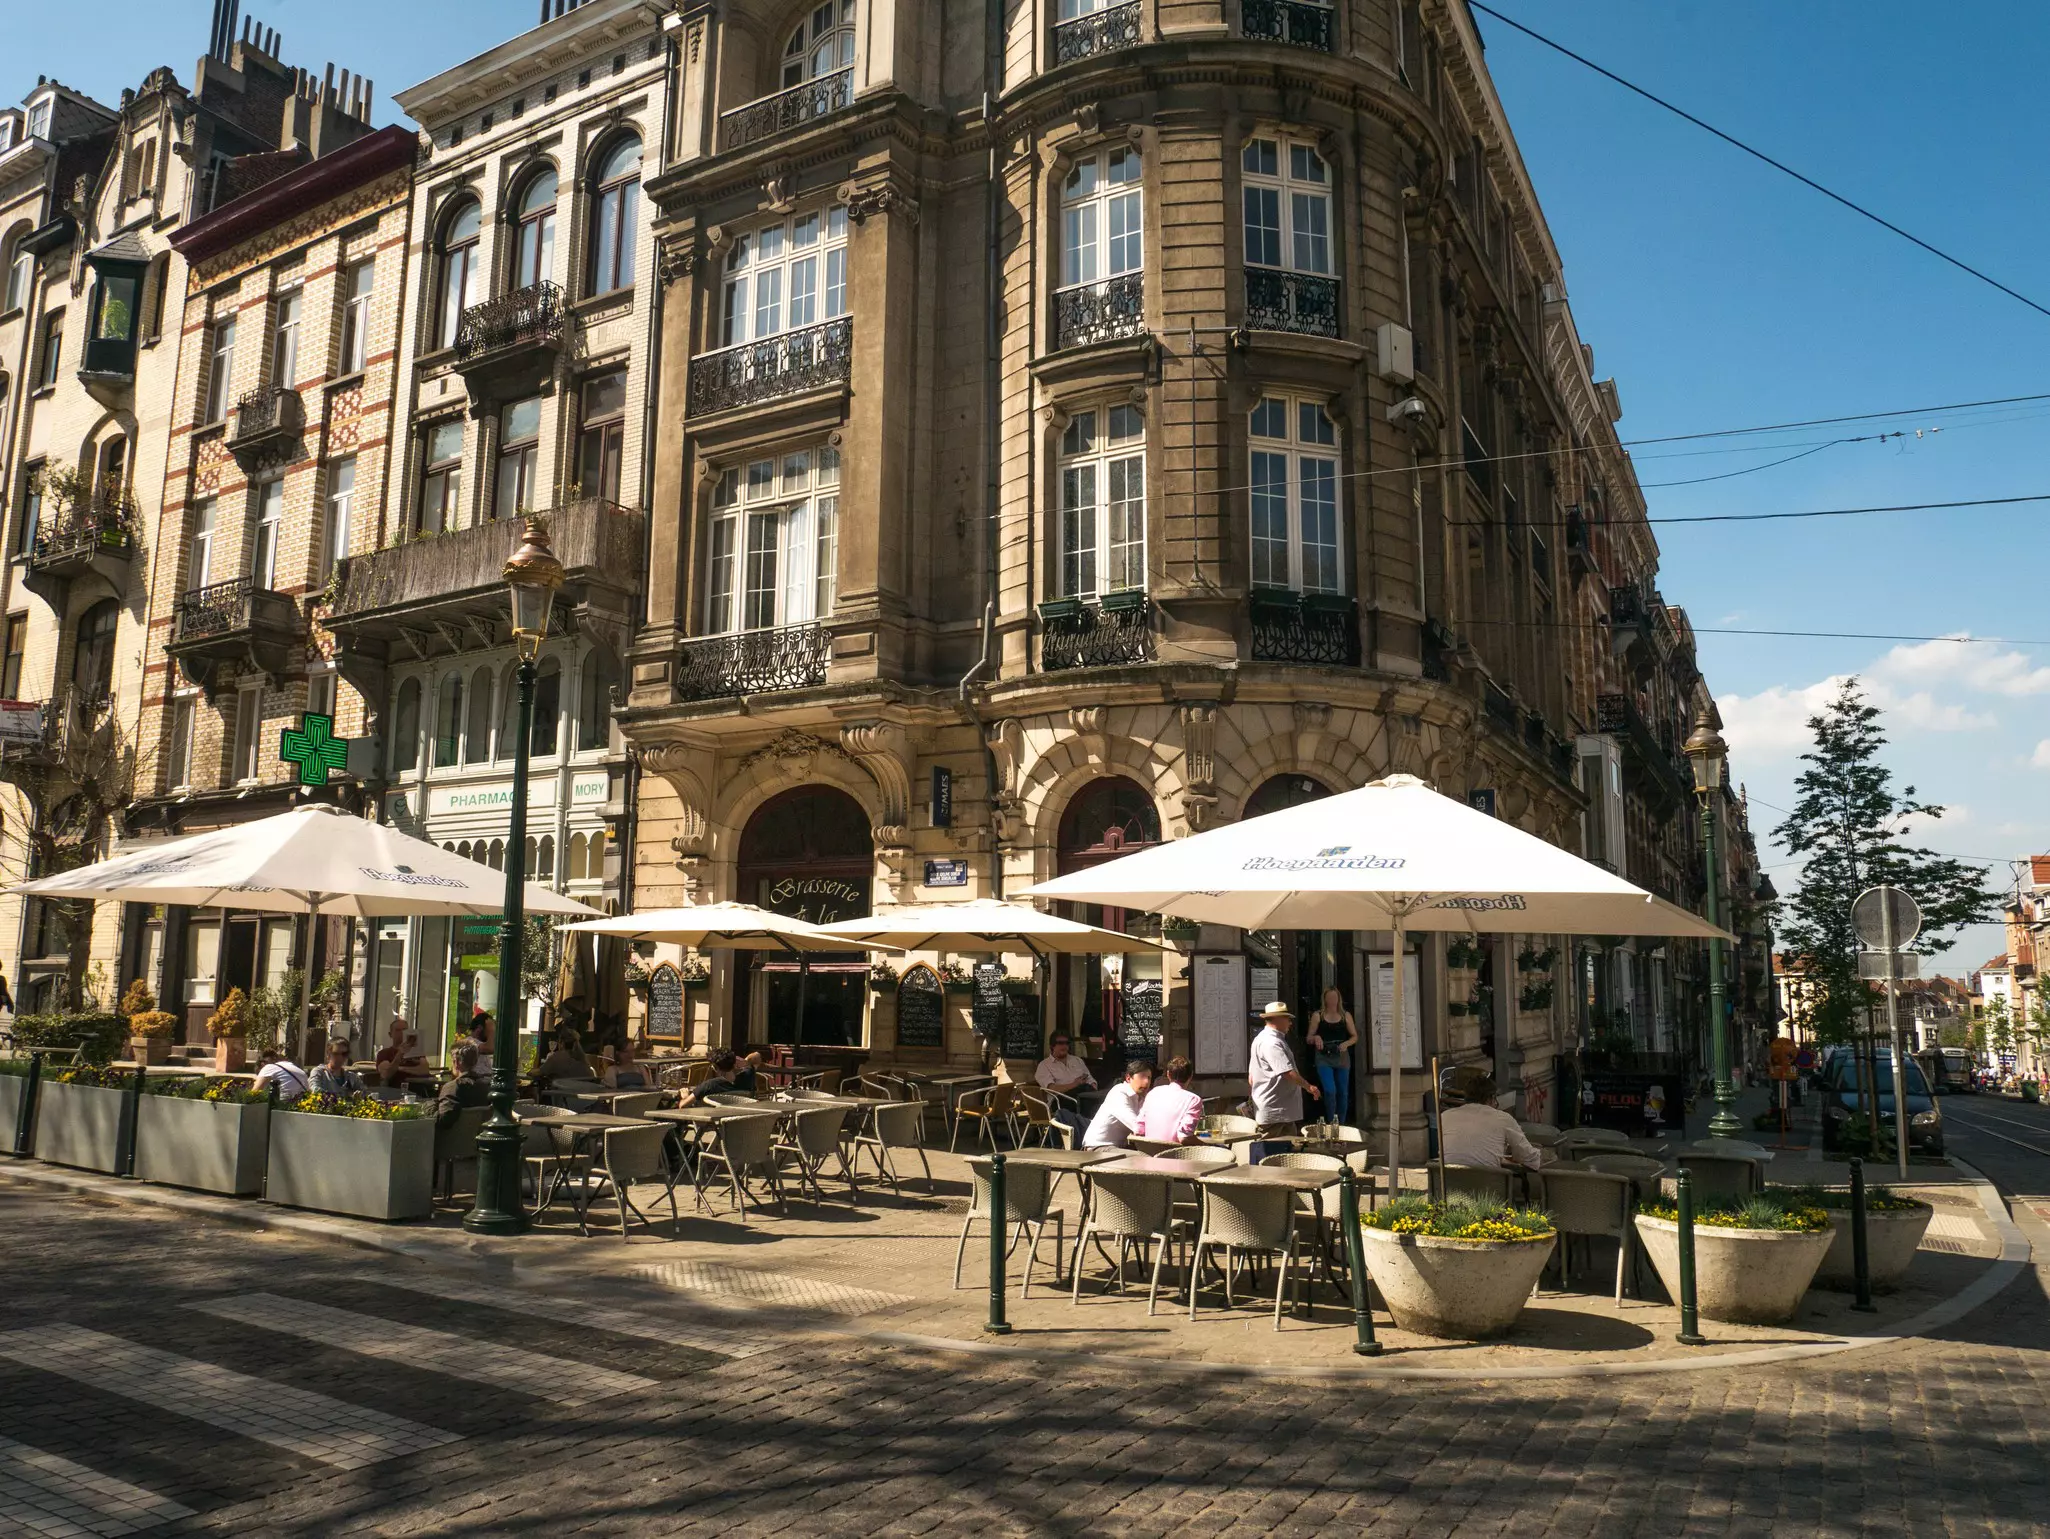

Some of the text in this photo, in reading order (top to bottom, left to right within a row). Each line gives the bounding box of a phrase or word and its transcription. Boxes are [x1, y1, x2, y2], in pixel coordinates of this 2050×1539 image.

[450, 783, 605, 807] PHARMACE MORY
[1242, 855, 1406, 871] Hoegaarden
[358, 867, 470, 888] Hoegaarden
[770, 877, 860, 904] Brasserie
